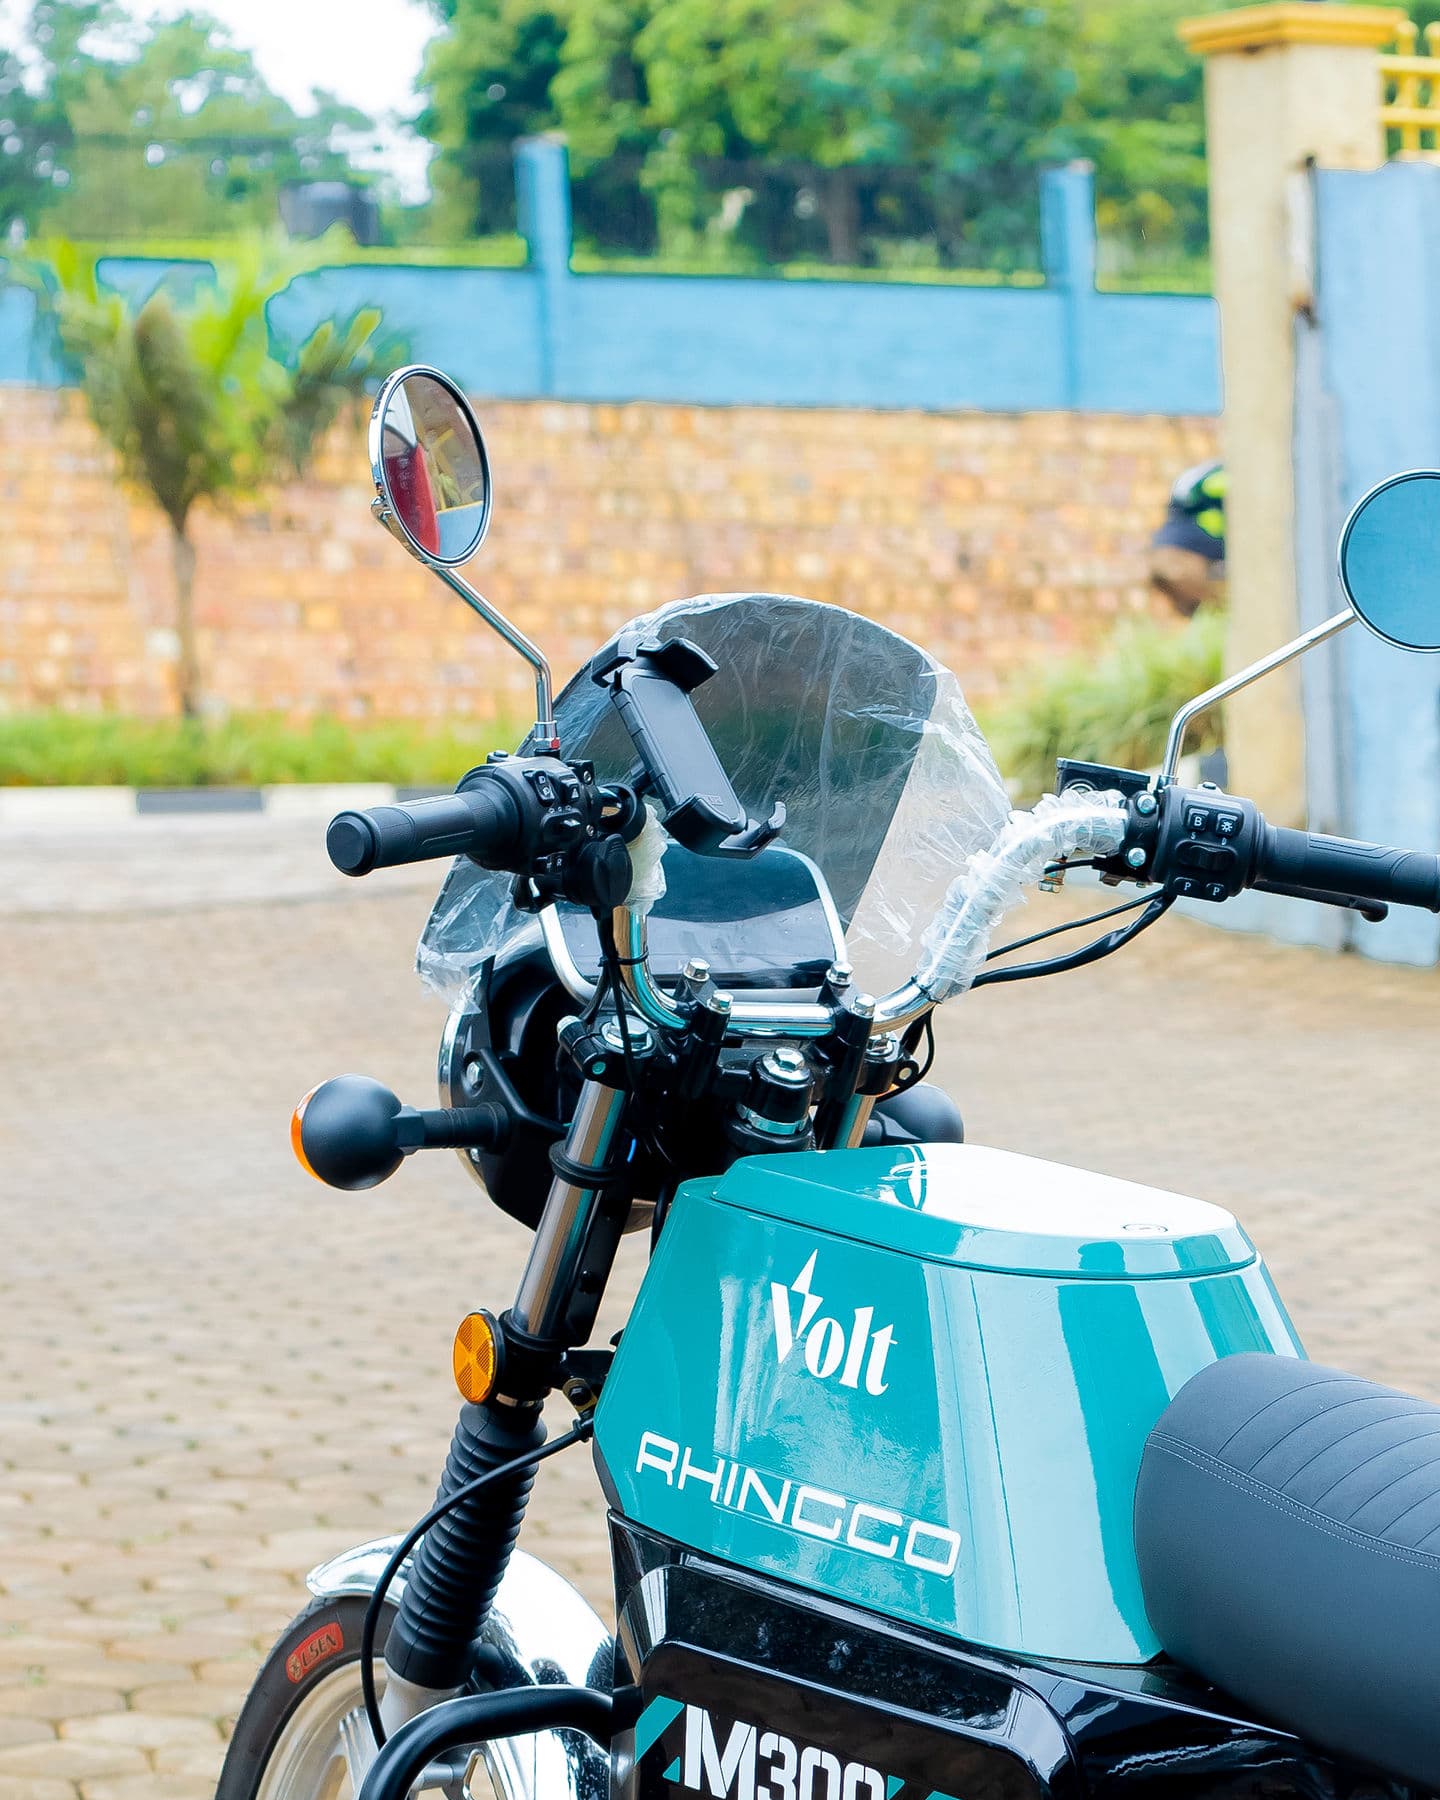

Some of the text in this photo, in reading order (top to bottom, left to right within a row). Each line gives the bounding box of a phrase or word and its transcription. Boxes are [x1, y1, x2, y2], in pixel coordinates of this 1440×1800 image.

[1193, 815, 1203, 827] B
[1183, 881, 1221, 896] P P
[770, 1248, 899, 1396] Volt
